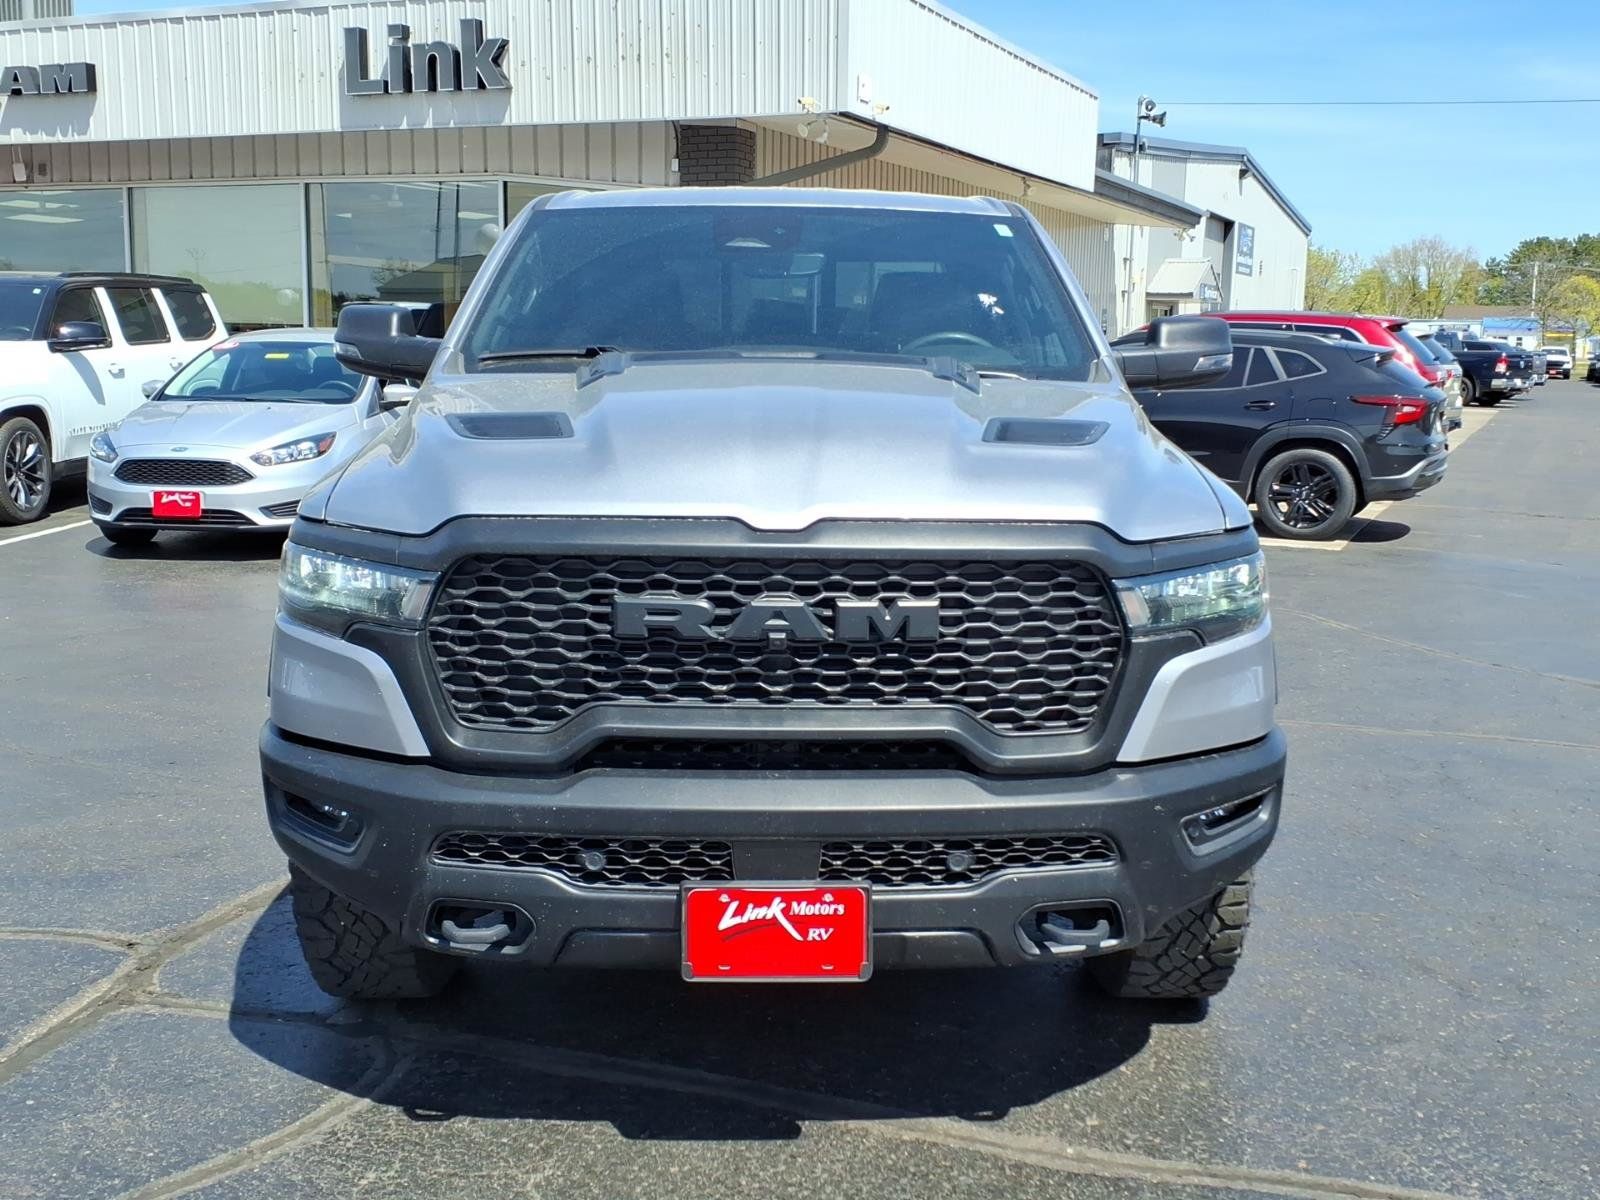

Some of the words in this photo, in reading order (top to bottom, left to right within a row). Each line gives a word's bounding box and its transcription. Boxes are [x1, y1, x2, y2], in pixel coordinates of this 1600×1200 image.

[344, 18, 512, 95] Link
[613, 595, 940, 641] RAM
[718, 897, 804, 941] Link
[790, 901, 845, 916] Motors
[807, 928, 833, 941] RV
